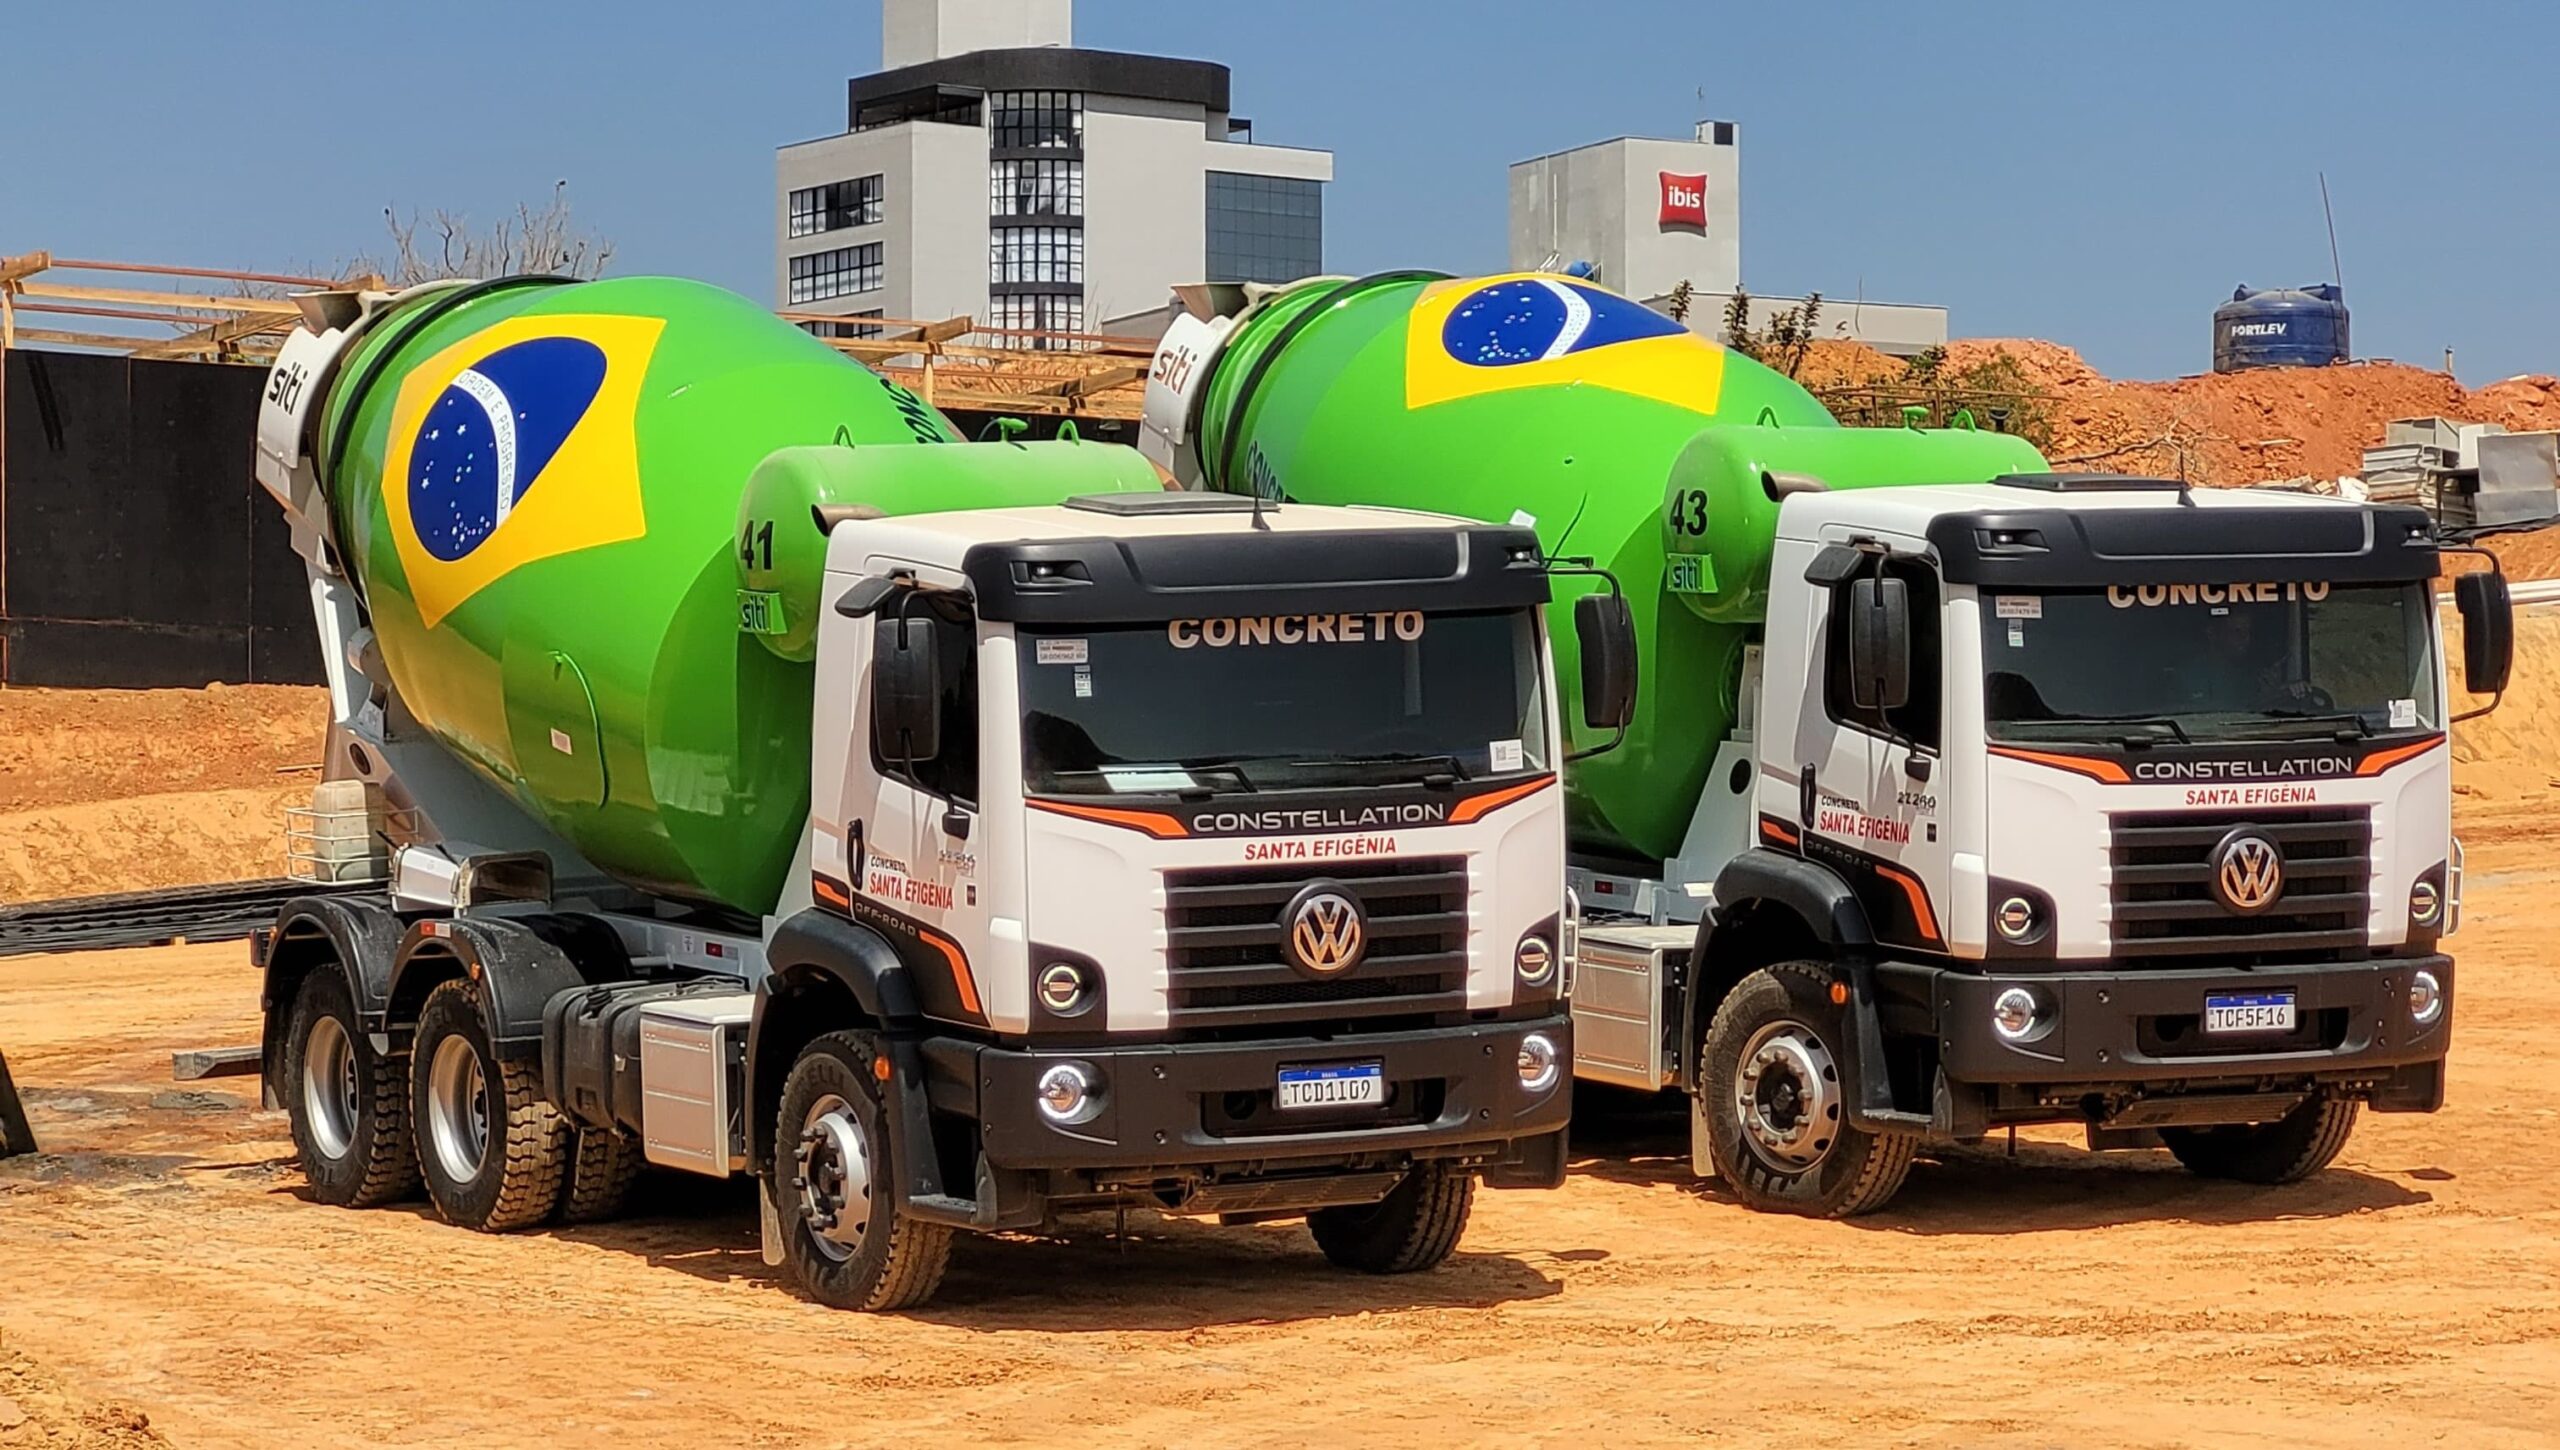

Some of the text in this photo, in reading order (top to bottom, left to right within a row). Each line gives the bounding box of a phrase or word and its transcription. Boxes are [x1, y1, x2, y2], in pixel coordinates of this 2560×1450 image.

[1668, 185, 1701, 208] ibis
[2231, 322, 2287, 337] FORTLEV
[1153, 343, 1198, 395] siti
[267, 361, 309, 416] siti
[1669, 488, 1708, 536] 43
[740, 519, 774, 570] 41
[1672, 557, 1699, 591] siti
[742, 595, 767, 631] siti
[1167, 610, 1425, 649] CONCRETO
[2135, 757, 2353, 780] CONSTELLATION
[1821, 795, 1860, 812] CONCRETO
[2185, 784, 2317, 806] SANTA EFIGÊNIA
[1192, 803, 1445, 833] CONSTELLATION
[1820, 810, 1855, 836] SANTA
[1857, 814, 1910, 845] EFIGÊNIA
[870, 855, 907, 873] CONCRETO
[1244, 834, 1397, 861] SANTA EFIGÊNIA
[1806, 840, 1872, 870] OFF-ROAD
[2221, 837, 2279, 907] VW
[869, 871, 902, 900] SANTA
[904, 877, 954, 911] EFIGÊNIA
[855, 902, 916, 937] OFF-ROAD
[1293, 893, 1361, 971] VW
[2216, 1007, 2285, 1028] TCF5F16
